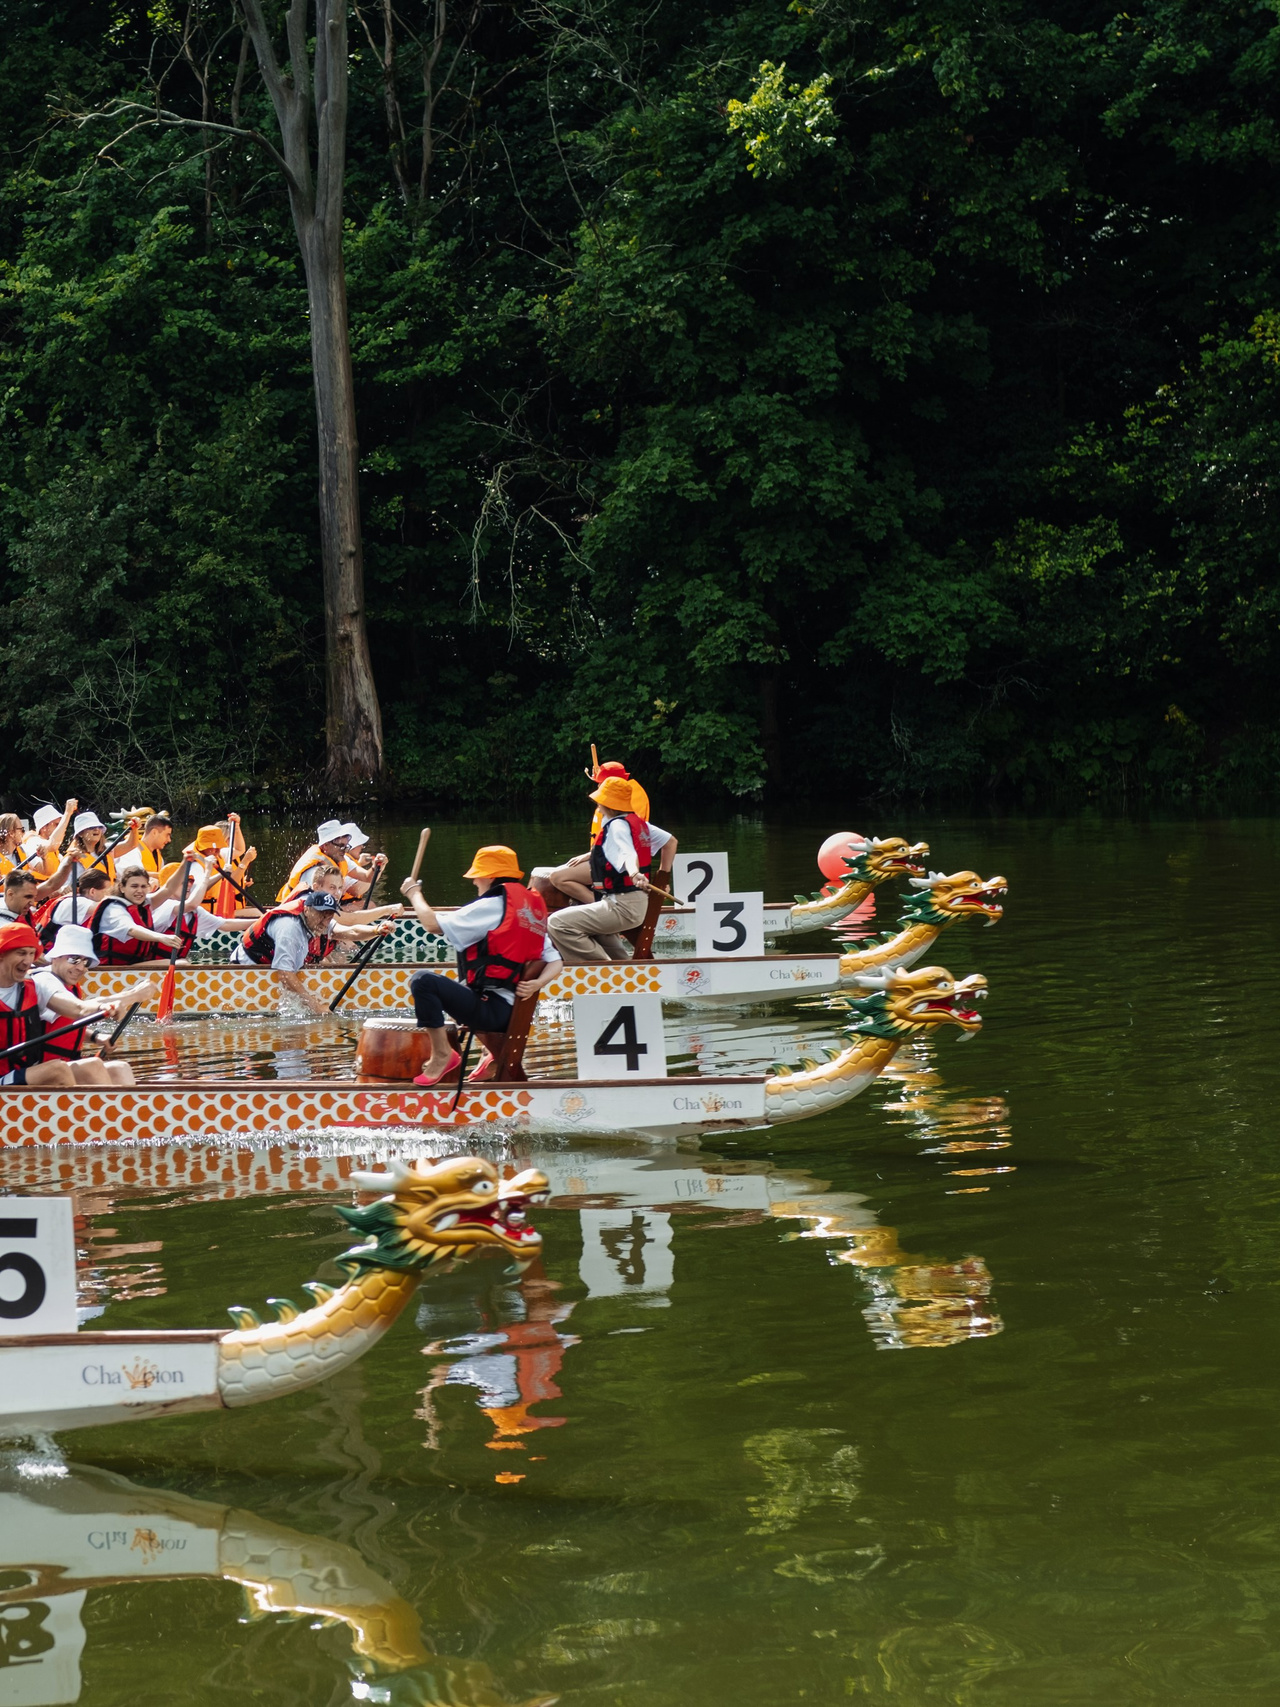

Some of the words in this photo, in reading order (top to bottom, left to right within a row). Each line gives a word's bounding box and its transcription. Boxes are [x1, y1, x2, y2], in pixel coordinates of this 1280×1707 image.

[687, 860, 714, 903] 2
[712, 901, 747, 952] 3
[770, 967, 822, 981] Chapion
[594, 1006, 648, 1071] 4
[673, 1095, 743, 1113] Chapion
[82, 1360, 185, 1389] Chapion
